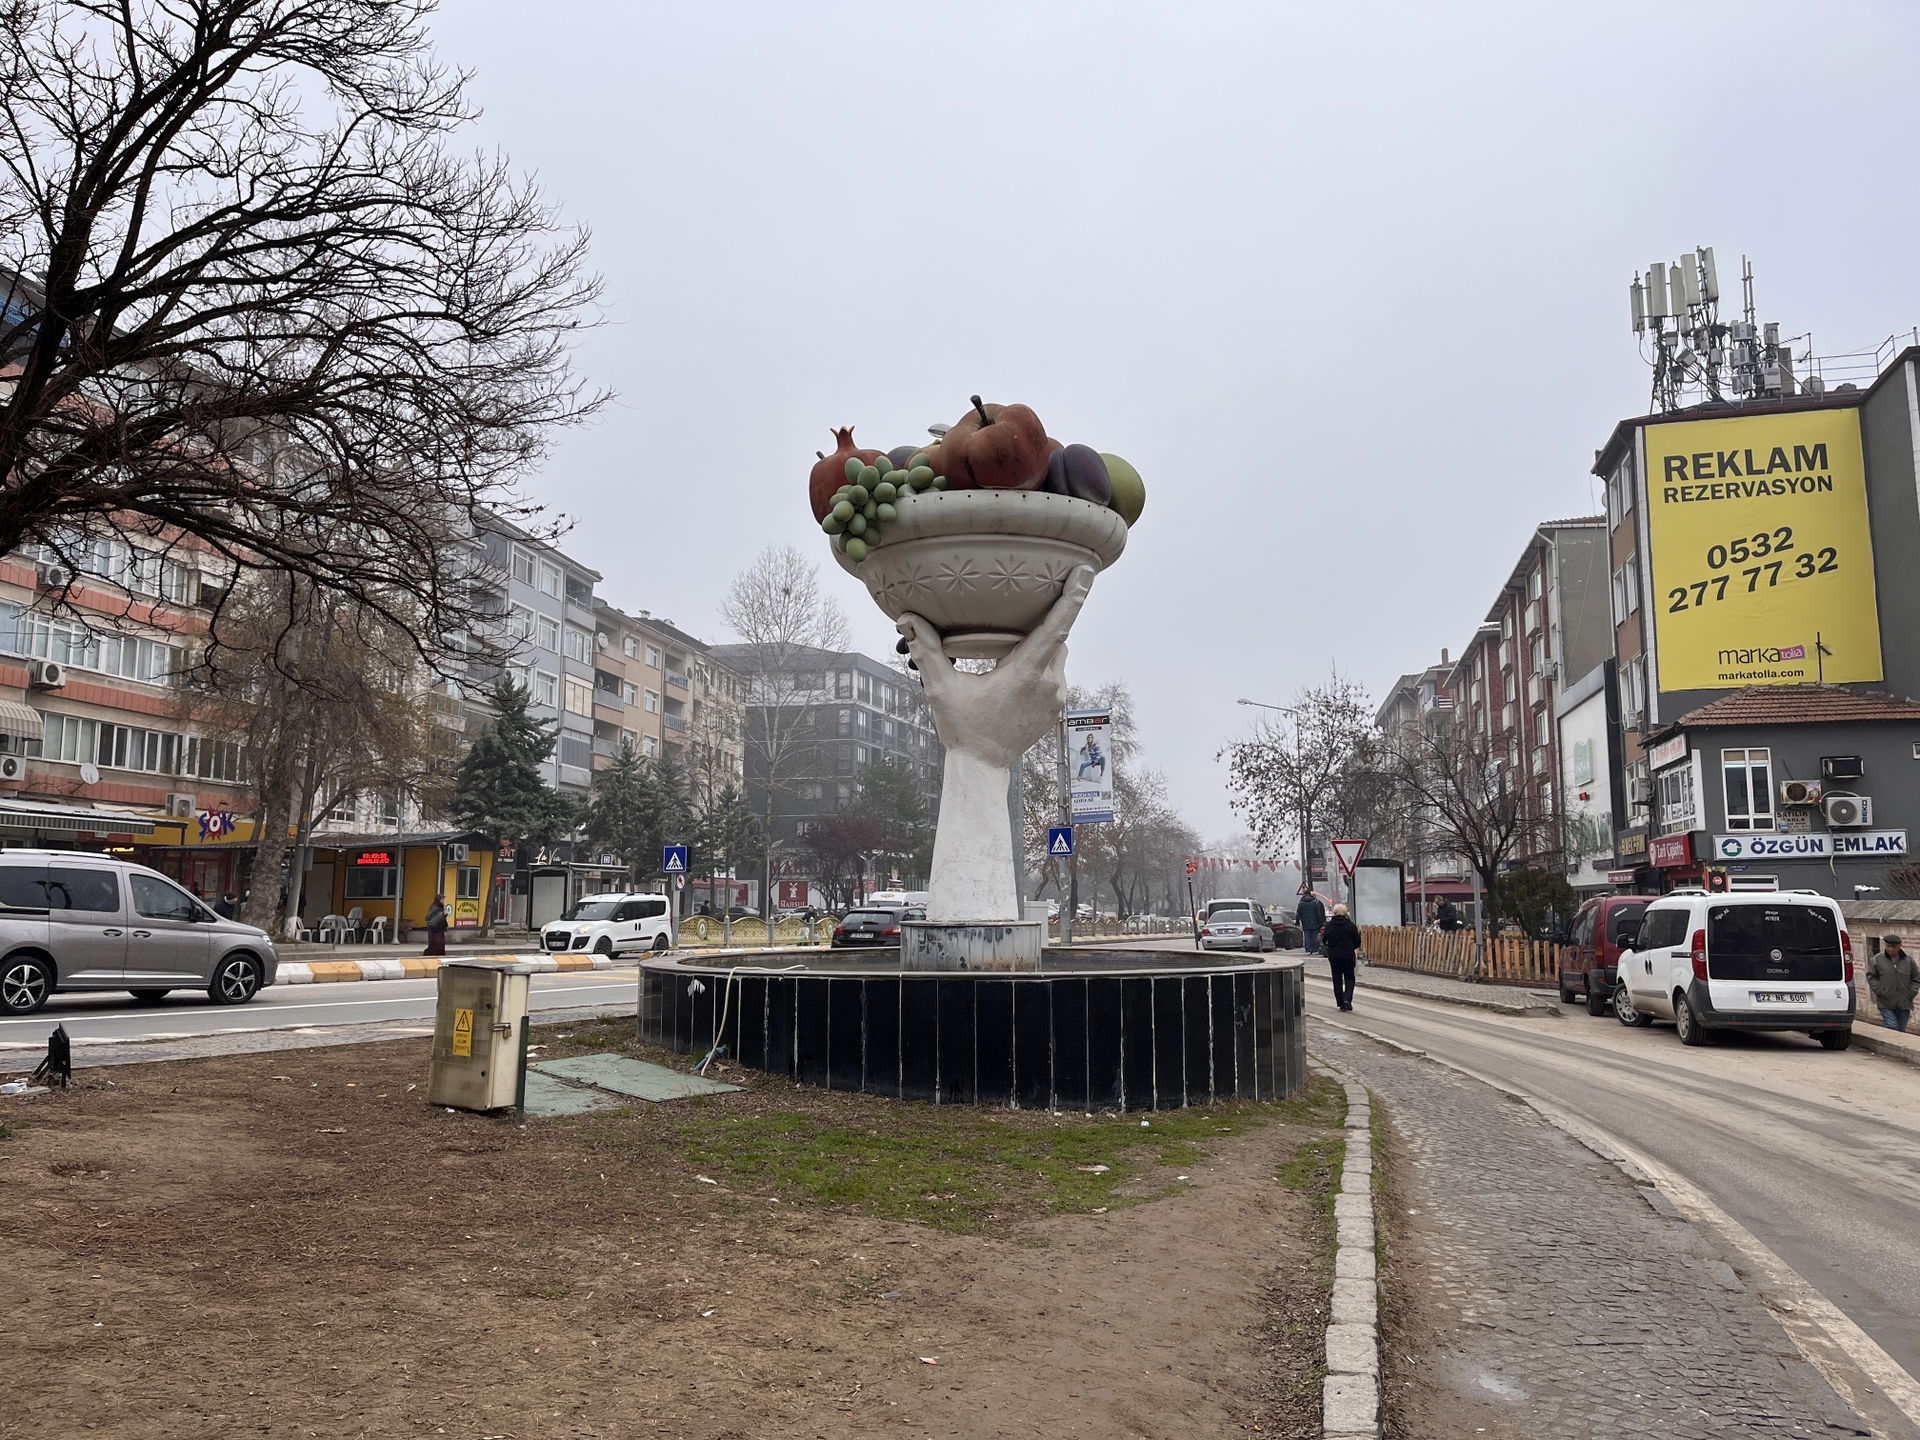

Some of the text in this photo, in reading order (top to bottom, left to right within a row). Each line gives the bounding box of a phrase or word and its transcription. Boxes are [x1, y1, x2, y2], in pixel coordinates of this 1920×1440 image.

[1663, 443, 1829, 482] REKLAM
[1663, 475, 1833, 503] REZERVASYON
[1707, 526, 1794, 569] 0532
[1668, 547, 1839, 613] 277 77 32
[1718, 669, 1804, 680] markatolia.com
[1750, 836, 1903, 854] ÖZGÜN EMLAK
[1761, 993, 1805, 1001] 22 NE 600
